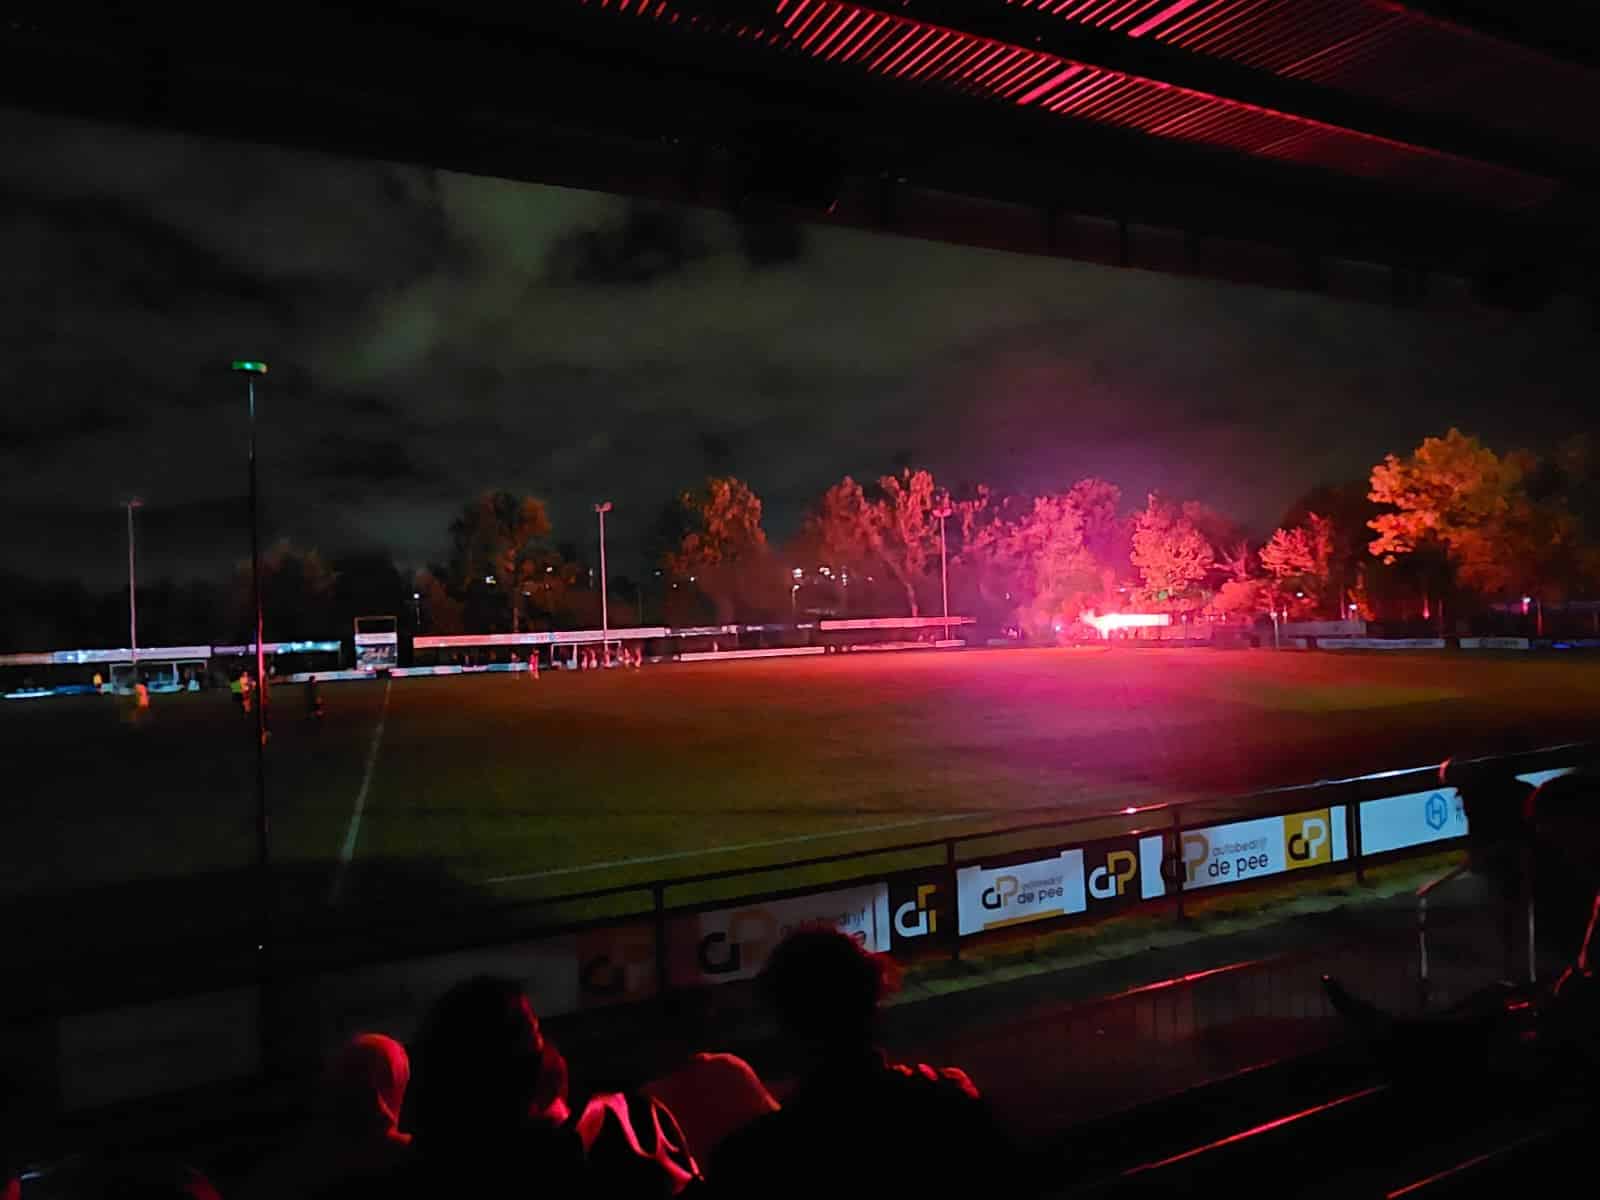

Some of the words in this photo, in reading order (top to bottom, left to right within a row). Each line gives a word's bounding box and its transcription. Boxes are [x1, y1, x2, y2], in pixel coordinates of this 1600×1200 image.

[1208, 857, 1230, 877] de
[1236, 854, 1269, 877] pee
[1017, 888, 1034, 904] de
[1039, 887, 1064, 904] pee
